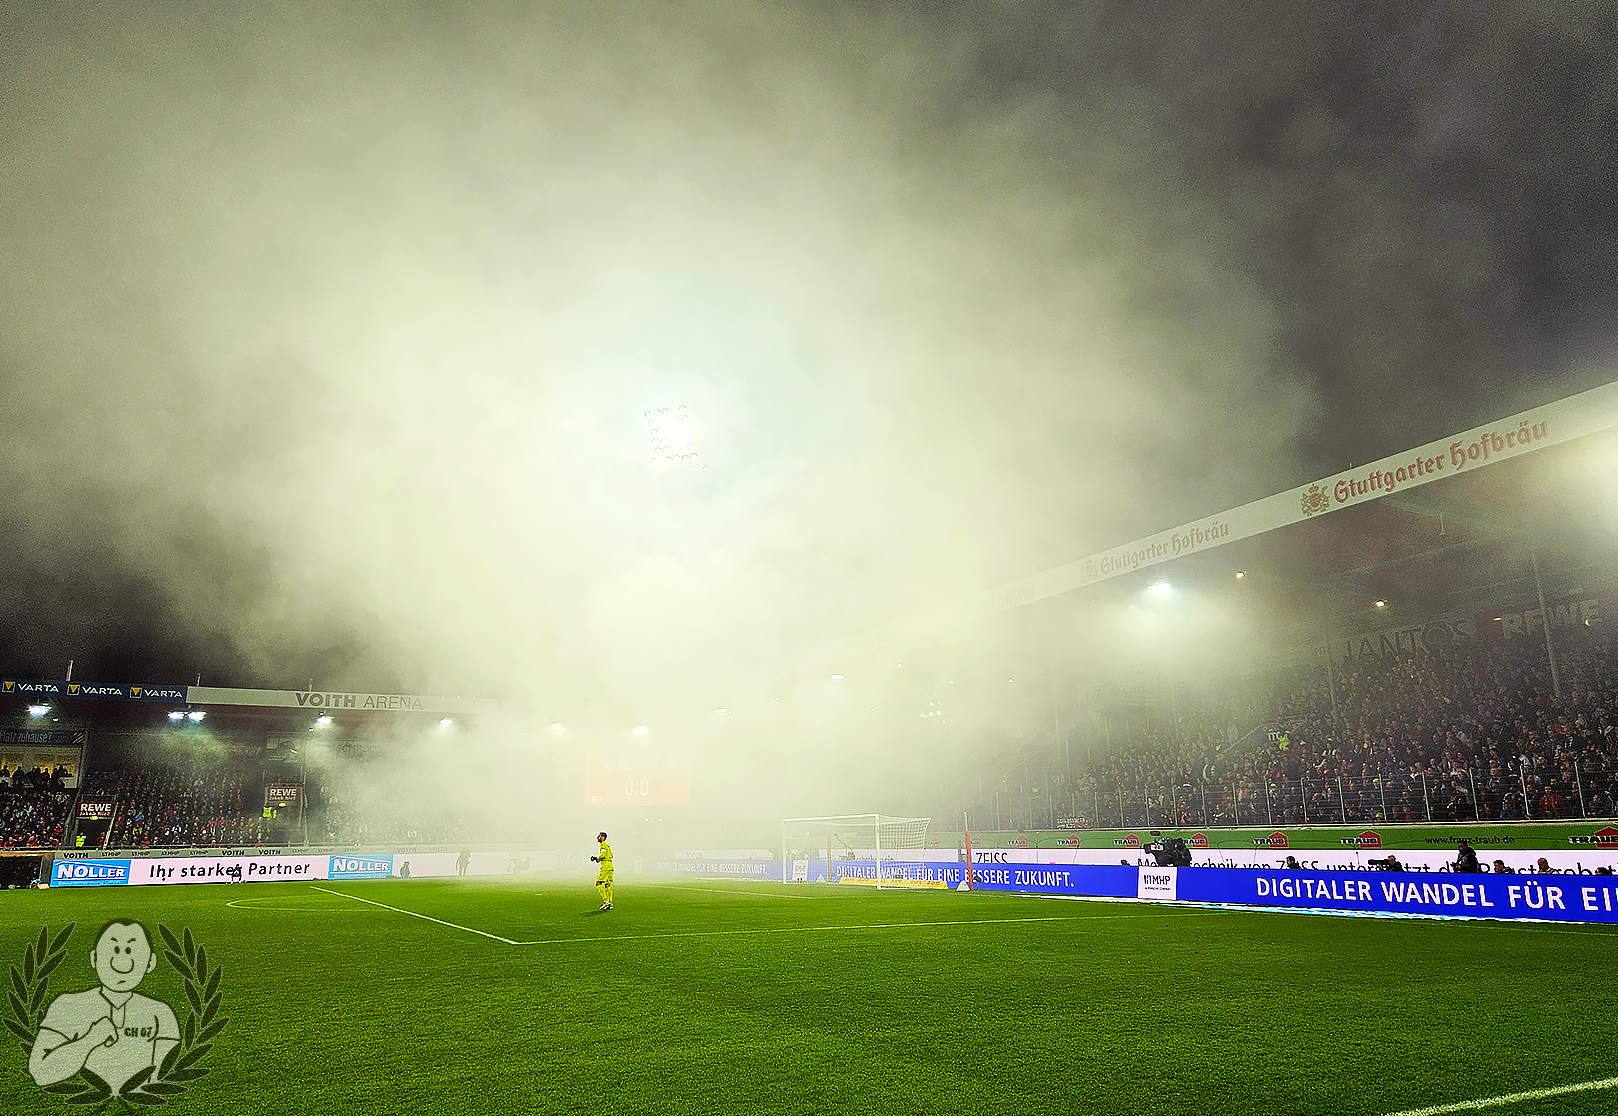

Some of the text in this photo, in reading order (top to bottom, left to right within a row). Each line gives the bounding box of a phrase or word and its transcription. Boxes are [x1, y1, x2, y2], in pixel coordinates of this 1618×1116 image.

[1333, 420, 1550, 503] Stuttgarter Hofbräu
[1100, 521, 1230, 575] Stuttgarter Hofbräu
[18, 683, 59, 693] VARTA
[82, 686, 123, 696] VARTA
[144, 689, 183, 699] VARTA
[295, 692, 424, 710] VOITH ARENA
[270, 788, 297, 796] REWE
[624, 777, 650, 797] 0:0
[80, 803, 112, 812] REWE
[1340, 837, 1379, 845] TRAUB
[1425, 835, 1515, 845] www.franz-traub.de
[57, 864, 125, 878] NOLLER
[149, 864, 175, 878] Ihr
[248, 862, 310, 876] Partner
[333, 859, 389, 872] NOLLER
[719, 863, 740, 874] BESSERE
[937, 868, 959, 882] EINE
[1015, 870, 1075, 888] ZUKUNFT.
[1153, 875, 1171, 885] MHP
[1256, 877, 1618, 912] DIGITALER WANDEL FÜR EI
